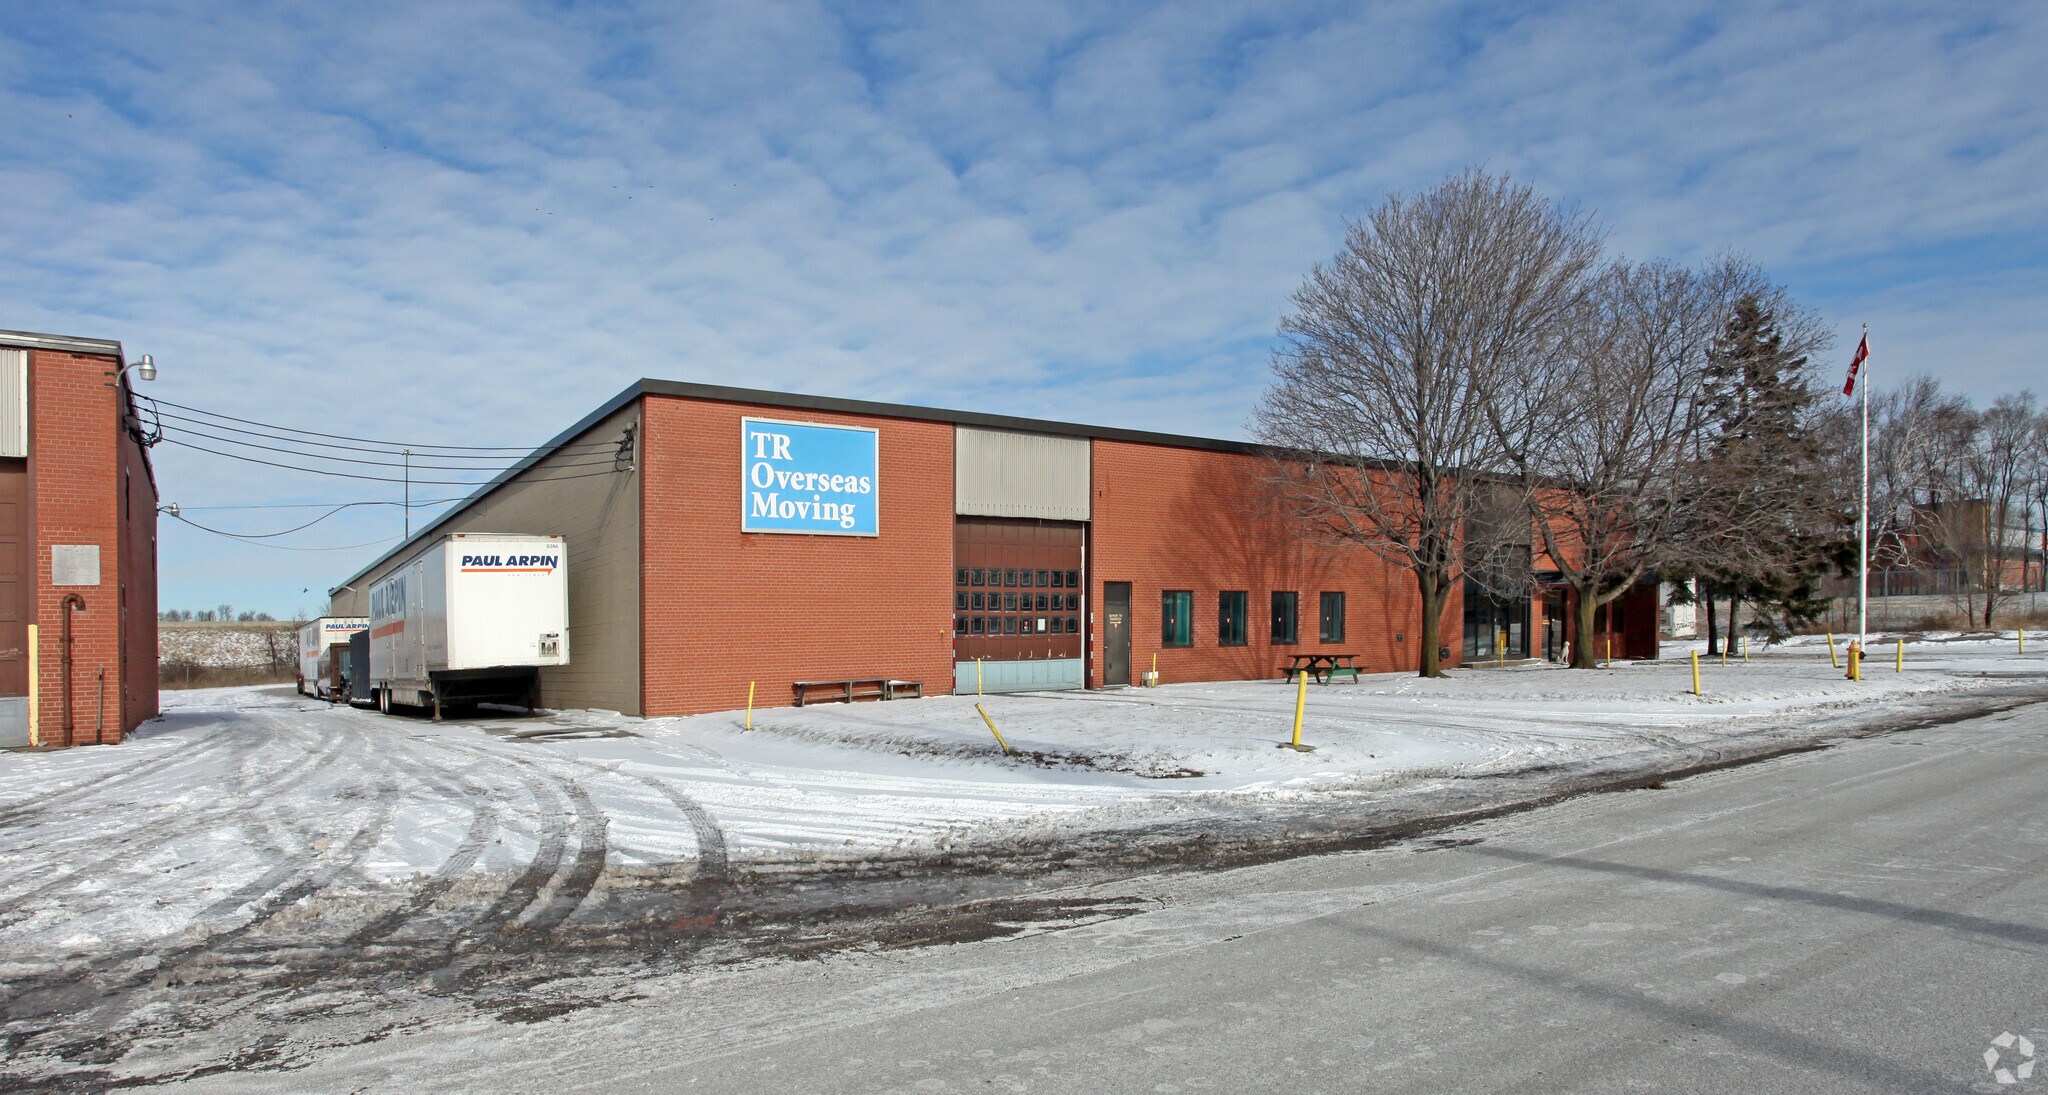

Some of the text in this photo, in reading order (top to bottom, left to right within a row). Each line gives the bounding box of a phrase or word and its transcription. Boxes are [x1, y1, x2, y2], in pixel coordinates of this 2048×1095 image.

[751, 431, 793, 460] TR
[751, 462, 871, 494] Overseas
[751, 492, 855, 529] Moving
[461, 555, 558, 569] PAUL ARPIN
